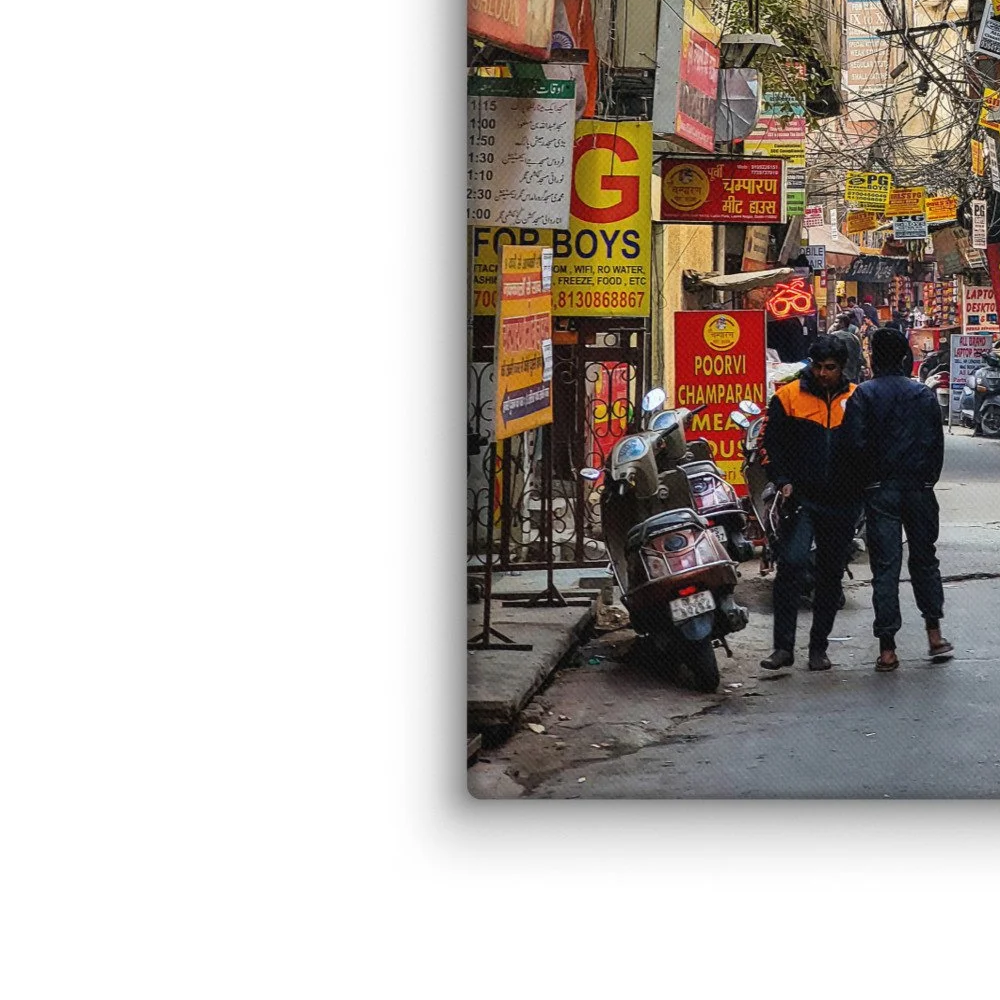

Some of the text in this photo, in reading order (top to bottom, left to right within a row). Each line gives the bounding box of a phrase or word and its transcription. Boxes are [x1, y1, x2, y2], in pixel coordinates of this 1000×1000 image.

[468, 153, 494, 163] 1:30
[467, 170, 493, 180] 1:10
[867, 175, 888, 185] PG
[722, 178, 778, 194] चम्पारण
[722, 195, 776, 214] मीट हाउस
[552, 229, 641, 259] BOYS
[575, 265, 645, 276] WIFI, RO WATER,
[558, 276, 594, 286] FREEZE,
[597, 276, 622, 285] FOOD
[695, 354, 746, 376] POORVI
[678, 383, 763, 406] CHAMPARAN
